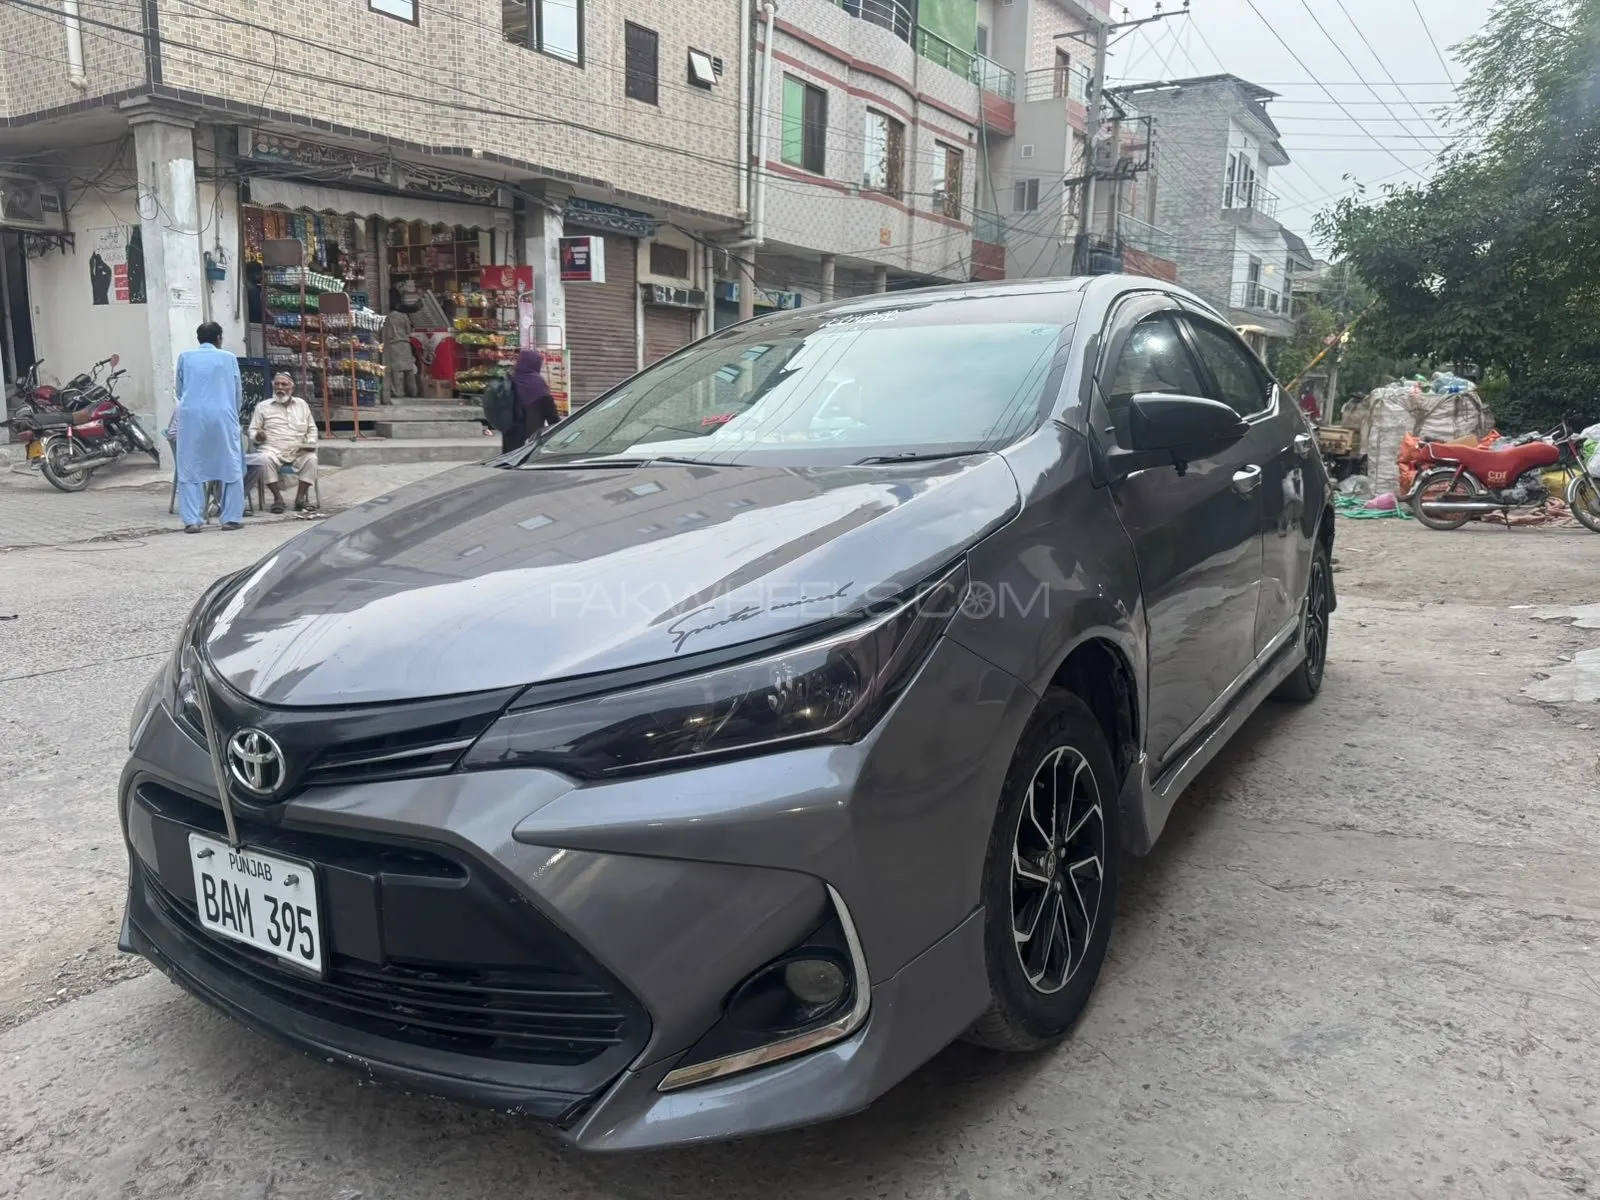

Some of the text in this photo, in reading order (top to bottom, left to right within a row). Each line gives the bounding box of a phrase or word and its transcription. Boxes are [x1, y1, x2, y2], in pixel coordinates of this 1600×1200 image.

[228, 852, 273, 881] PUNJAB
[201, 872, 315, 961] BAM 395
